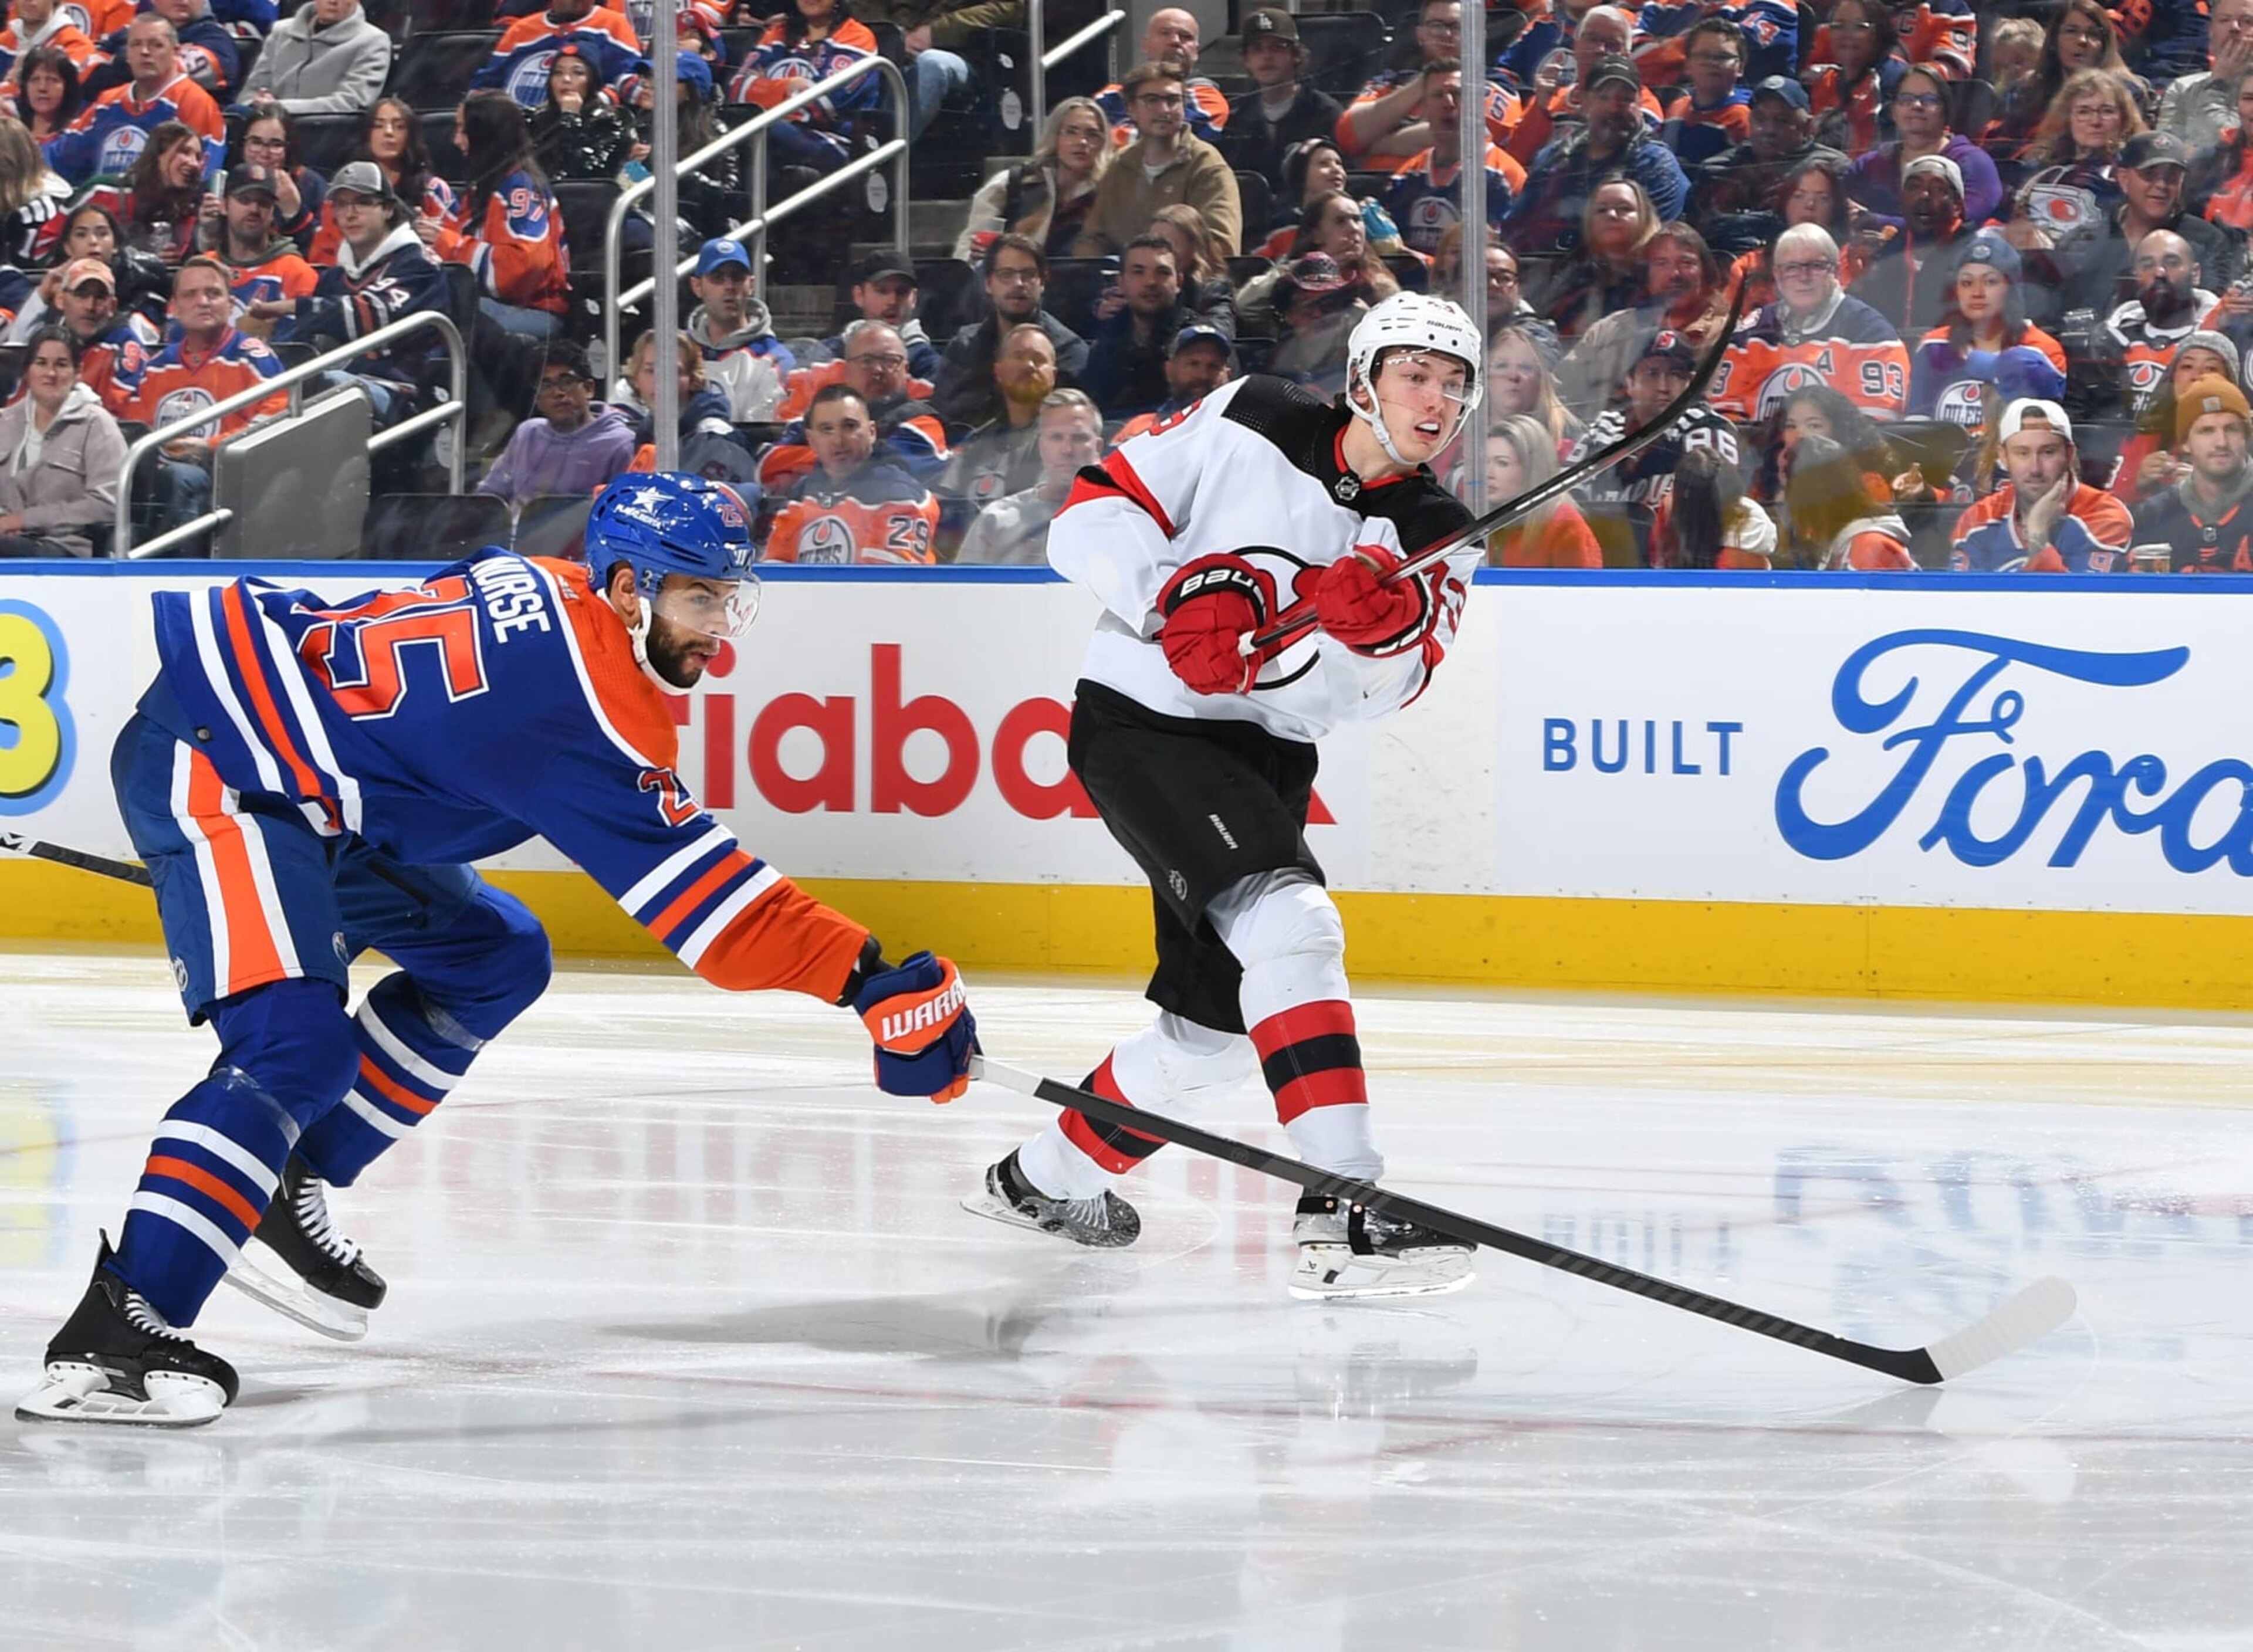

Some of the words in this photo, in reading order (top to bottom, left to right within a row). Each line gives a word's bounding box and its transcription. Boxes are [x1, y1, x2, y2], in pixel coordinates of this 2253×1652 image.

[1816, 348, 1836, 377] A
[1860, 359, 1904, 401] 93
[886, 514, 931, 558] 29
[469, 556, 551, 644] NURSE
[1543, 717, 1743, 776] BUILT
[882, 979, 967, 1042] WARR
